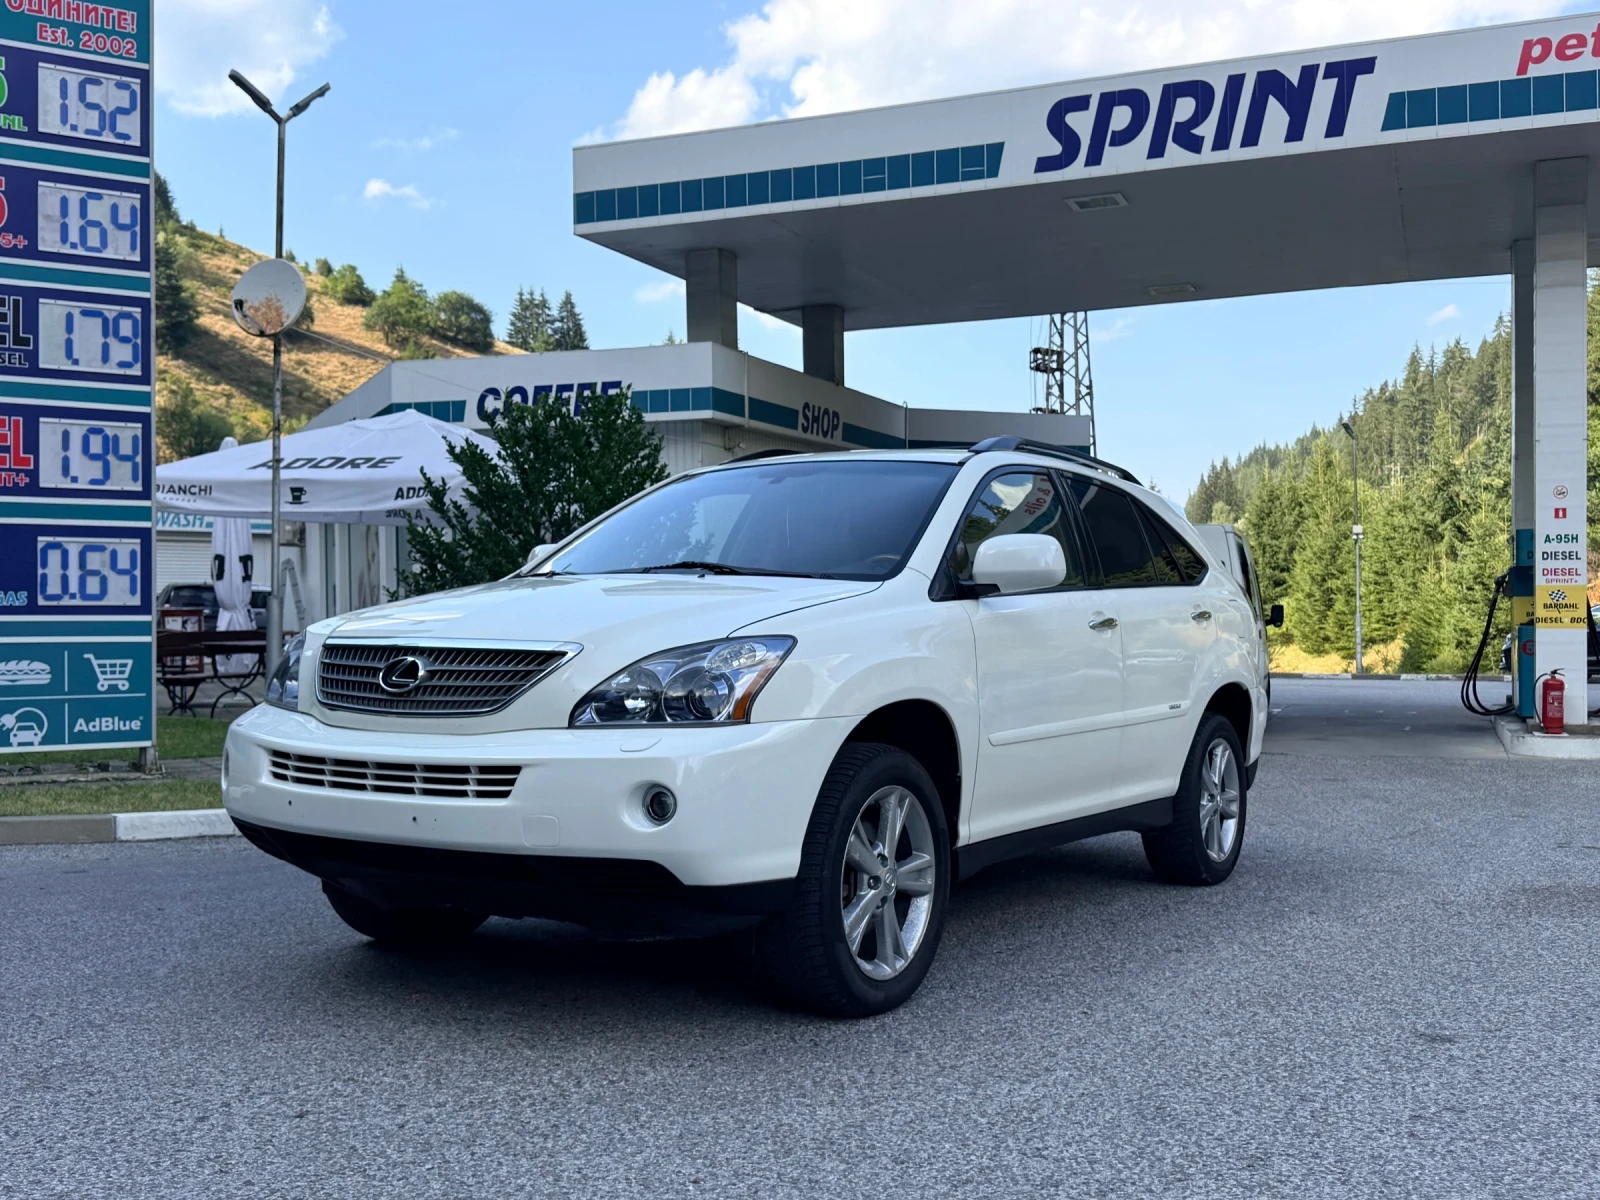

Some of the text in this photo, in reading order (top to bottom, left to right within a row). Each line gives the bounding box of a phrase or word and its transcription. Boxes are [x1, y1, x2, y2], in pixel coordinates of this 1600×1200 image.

[37, 22, 137, 58] Est. 2002
[59, 76, 138, 141] 1.52
[1034, 56, 1378, 174] SPRINT
[59, 191, 139, 253] 1.64
[65, 308, 140, 369] 1.79
[801, 401, 840, 440] SHOP
[61, 426, 140, 486] 1.94
[246, 456, 403, 471] ADORE
[0, 472, 30, 487] T+
[1541, 550, 1582, 561] DIESEL
[1543, 533, 1579, 544] A-95H
[39, 541, 138, 602] 0.64
[1541, 567, 1582, 577] DIESEL
[1535, 616, 1564, 624] DIESEL
[1543, 602, 1579, 610] BARDAHL
